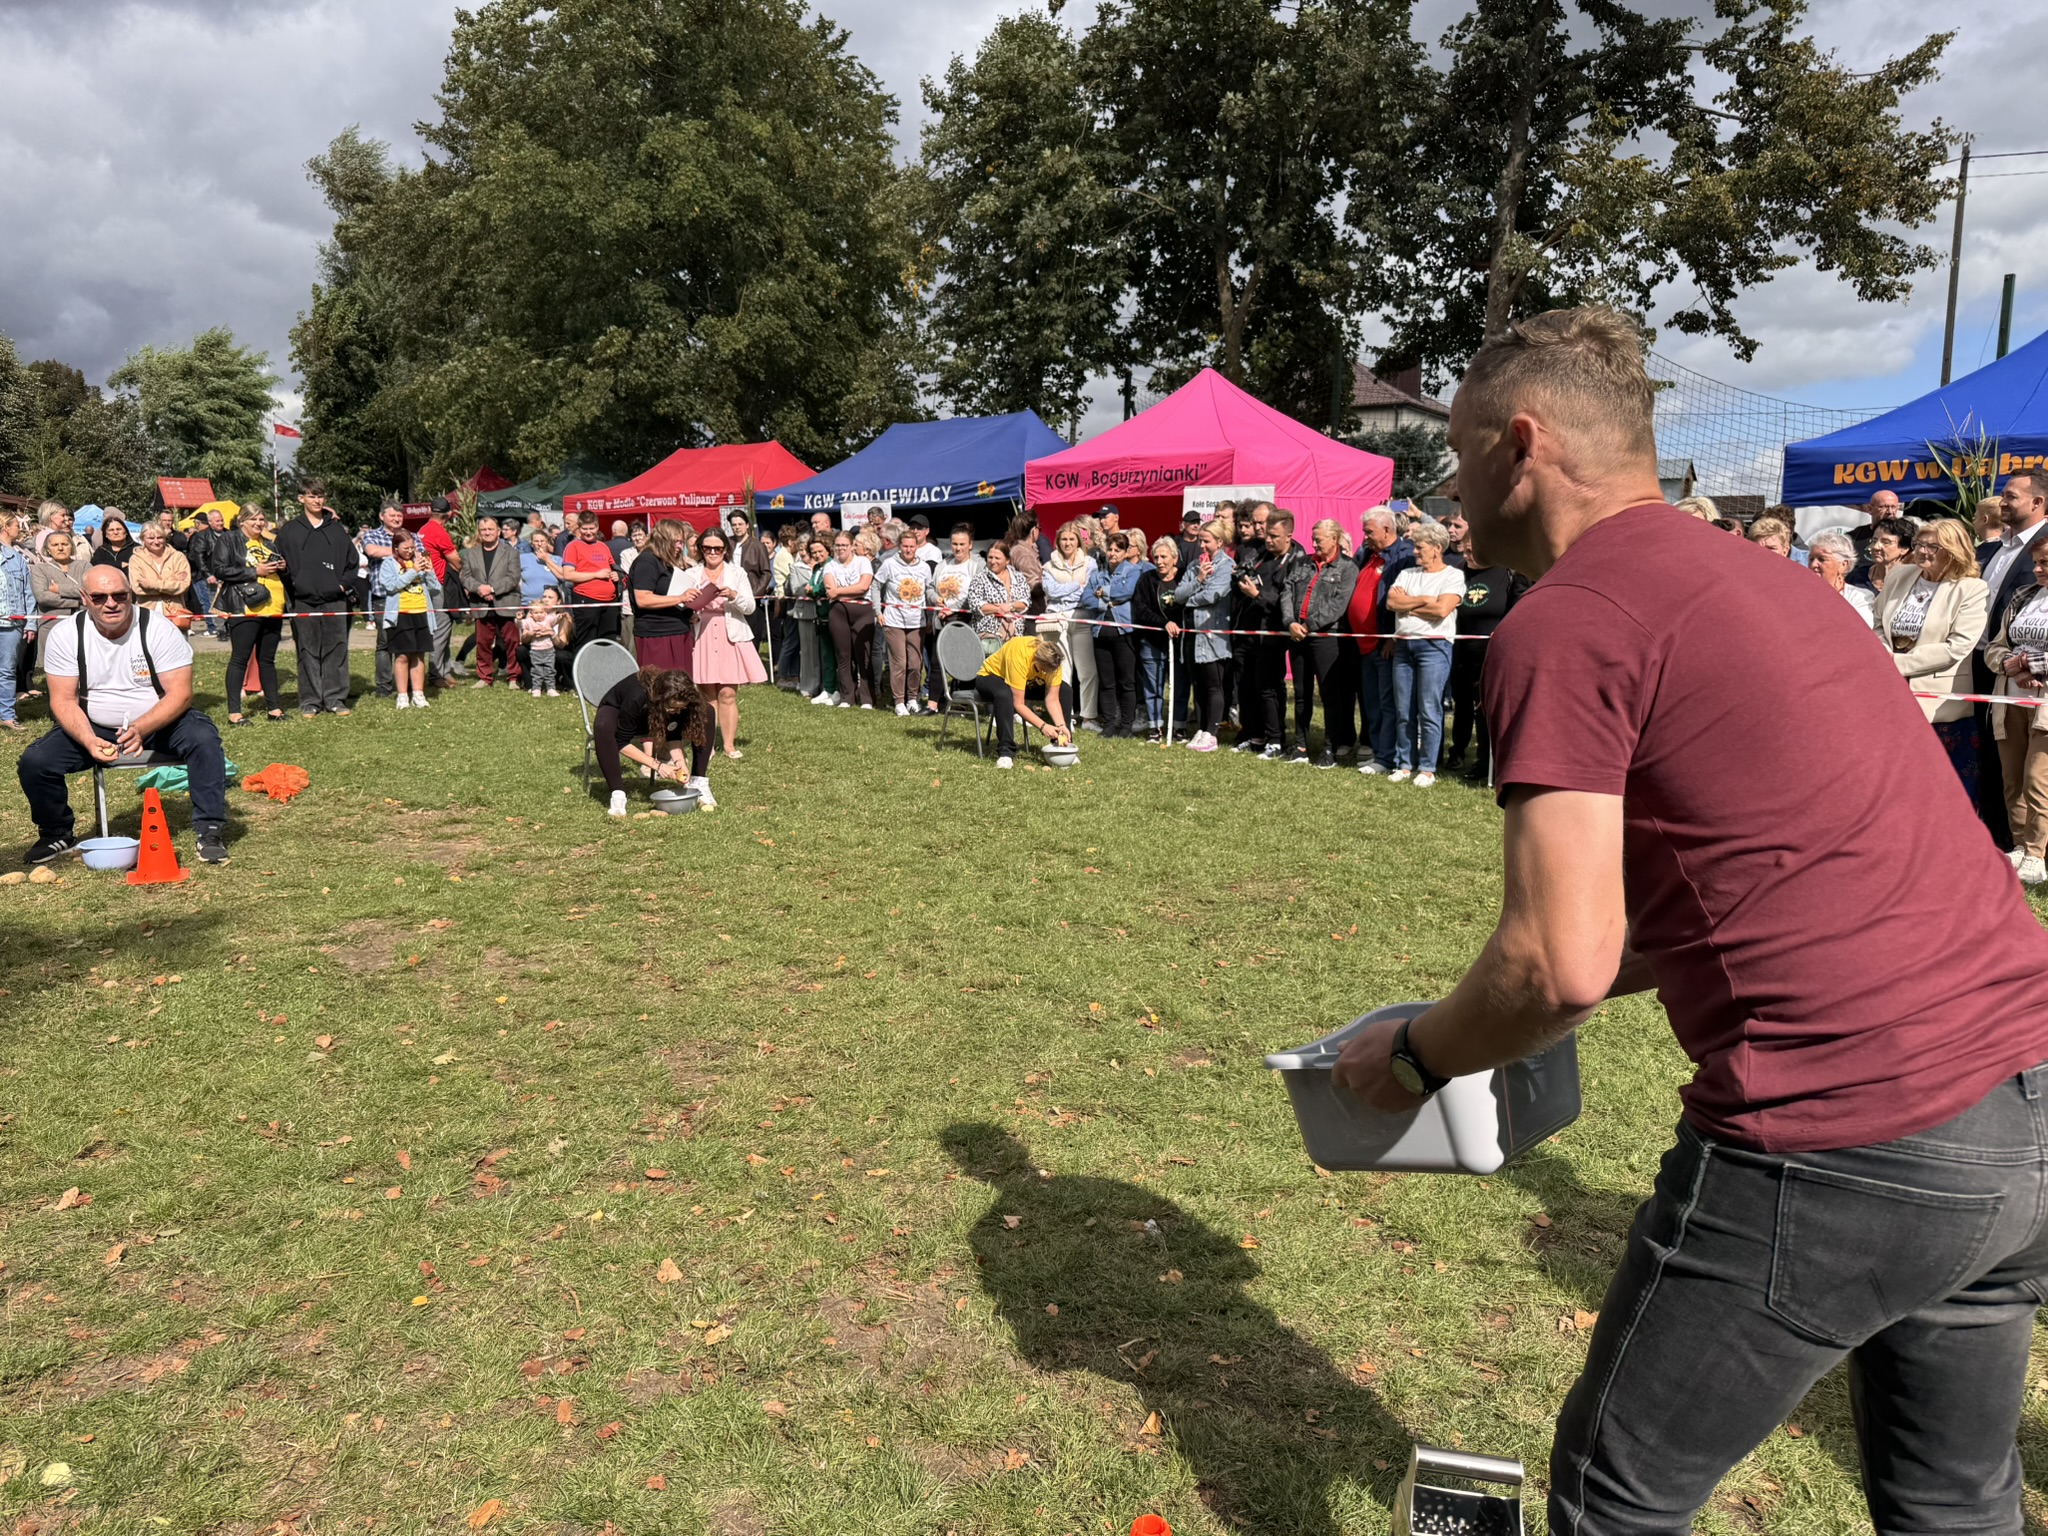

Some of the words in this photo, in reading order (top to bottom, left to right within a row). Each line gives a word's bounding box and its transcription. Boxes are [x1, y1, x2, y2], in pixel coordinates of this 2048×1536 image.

[1834, 459, 1909, 485] KGW
[1914, 461, 1942, 480] w
[1045, 472, 1080, 490] KGW
[587, 499, 605, 510] KGW
[803, 493, 835, 510] KGW
